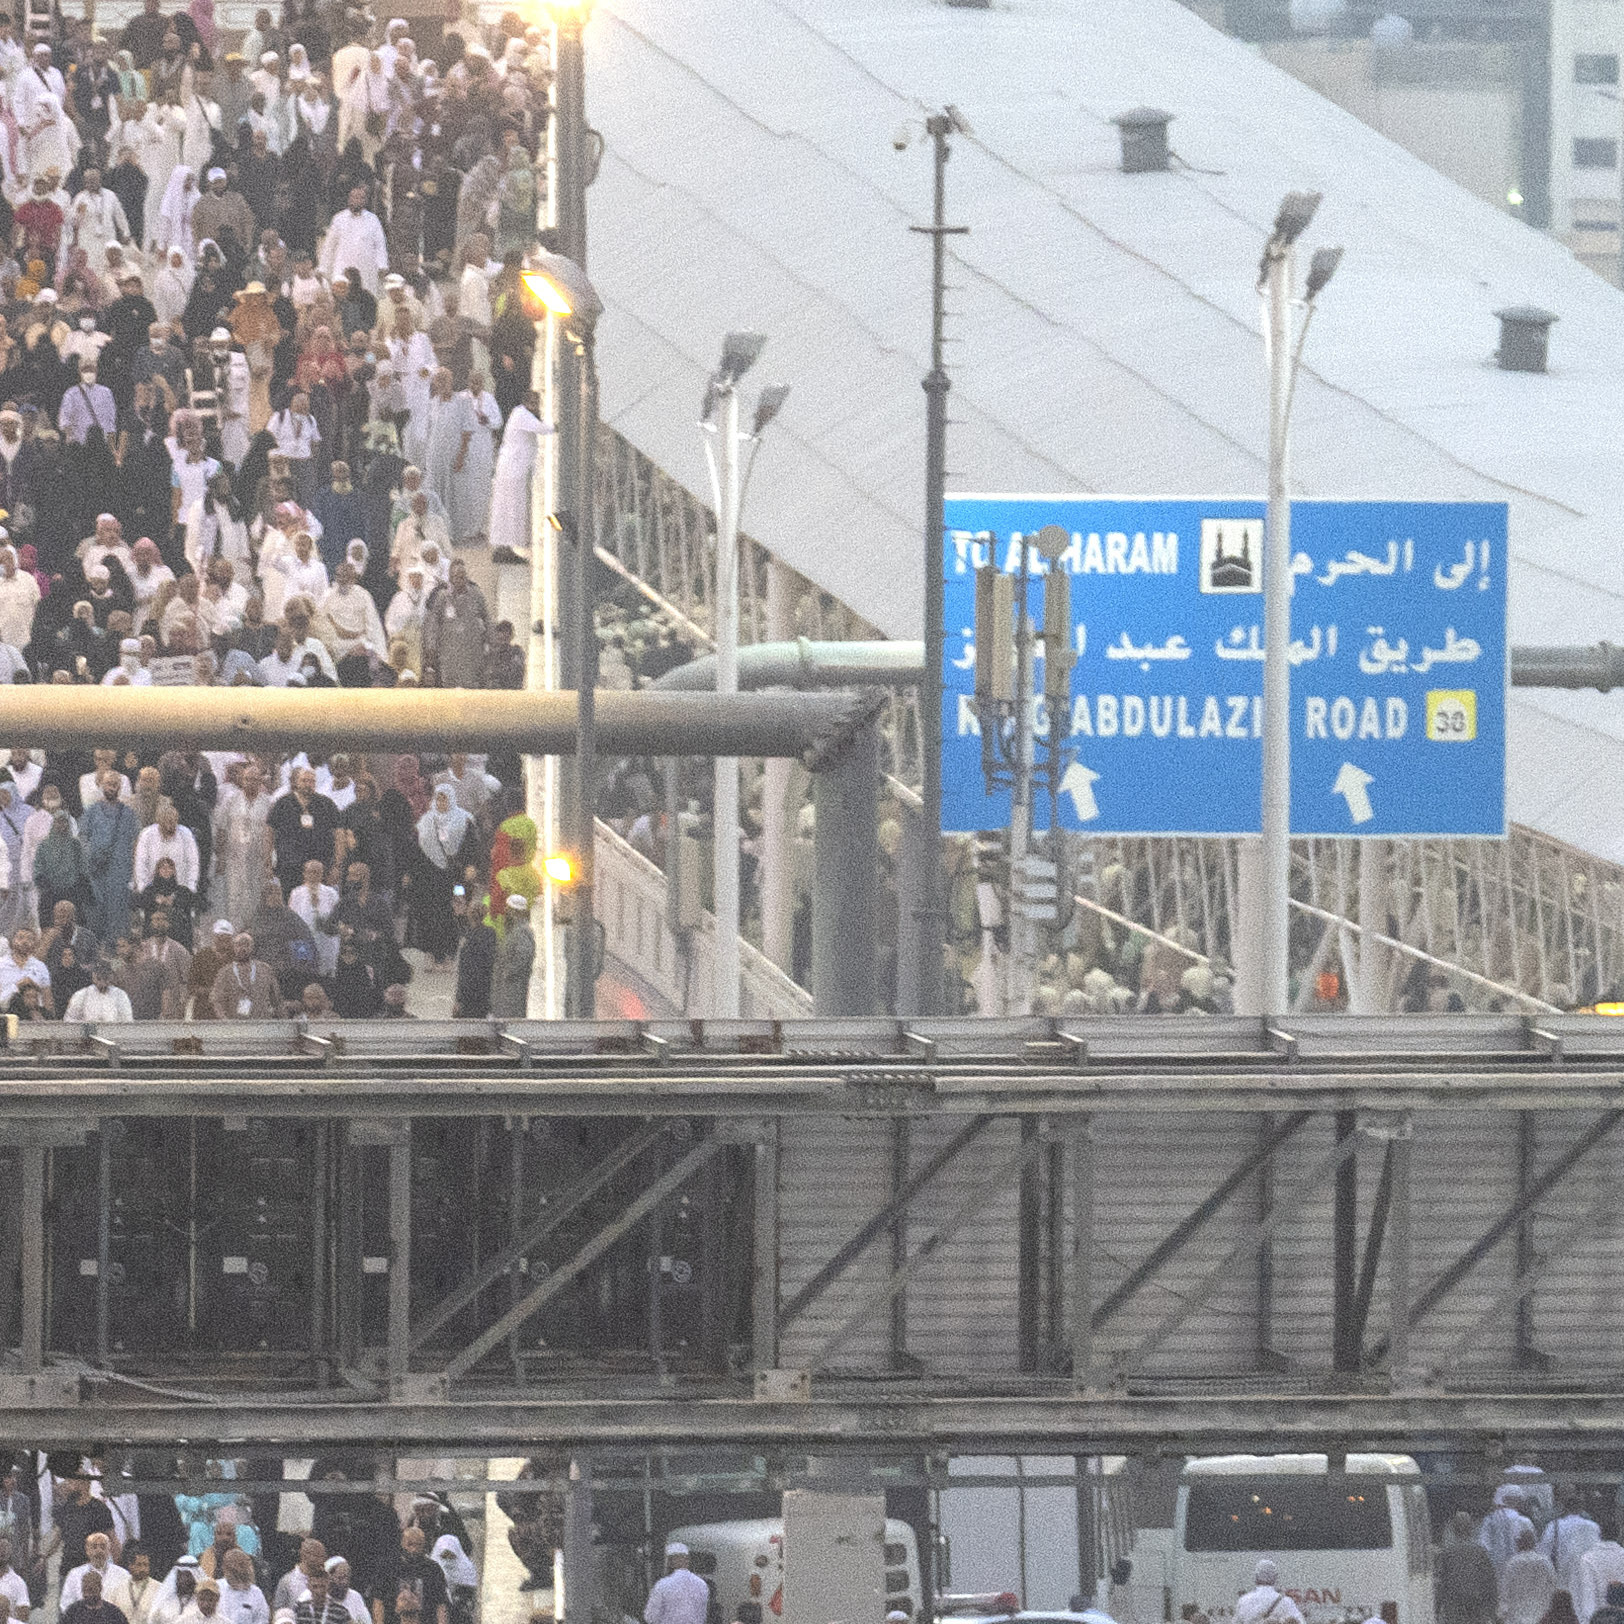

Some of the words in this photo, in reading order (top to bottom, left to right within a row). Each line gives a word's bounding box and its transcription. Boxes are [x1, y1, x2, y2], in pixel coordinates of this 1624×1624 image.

[1058, 531, 1178, 575] HARAM
[1287, 538, 1414, 598] الحرم
[1433, 540, 1492, 592] إلى
[1106, 631, 1192, 672] عبد
[1360, 625, 1482, 675] طريق
[957, 694, 1052, 737] KG
[1070, 694, 1265, 739] ABDULAZI
[1306, 696, 1409, 740] ROAD
